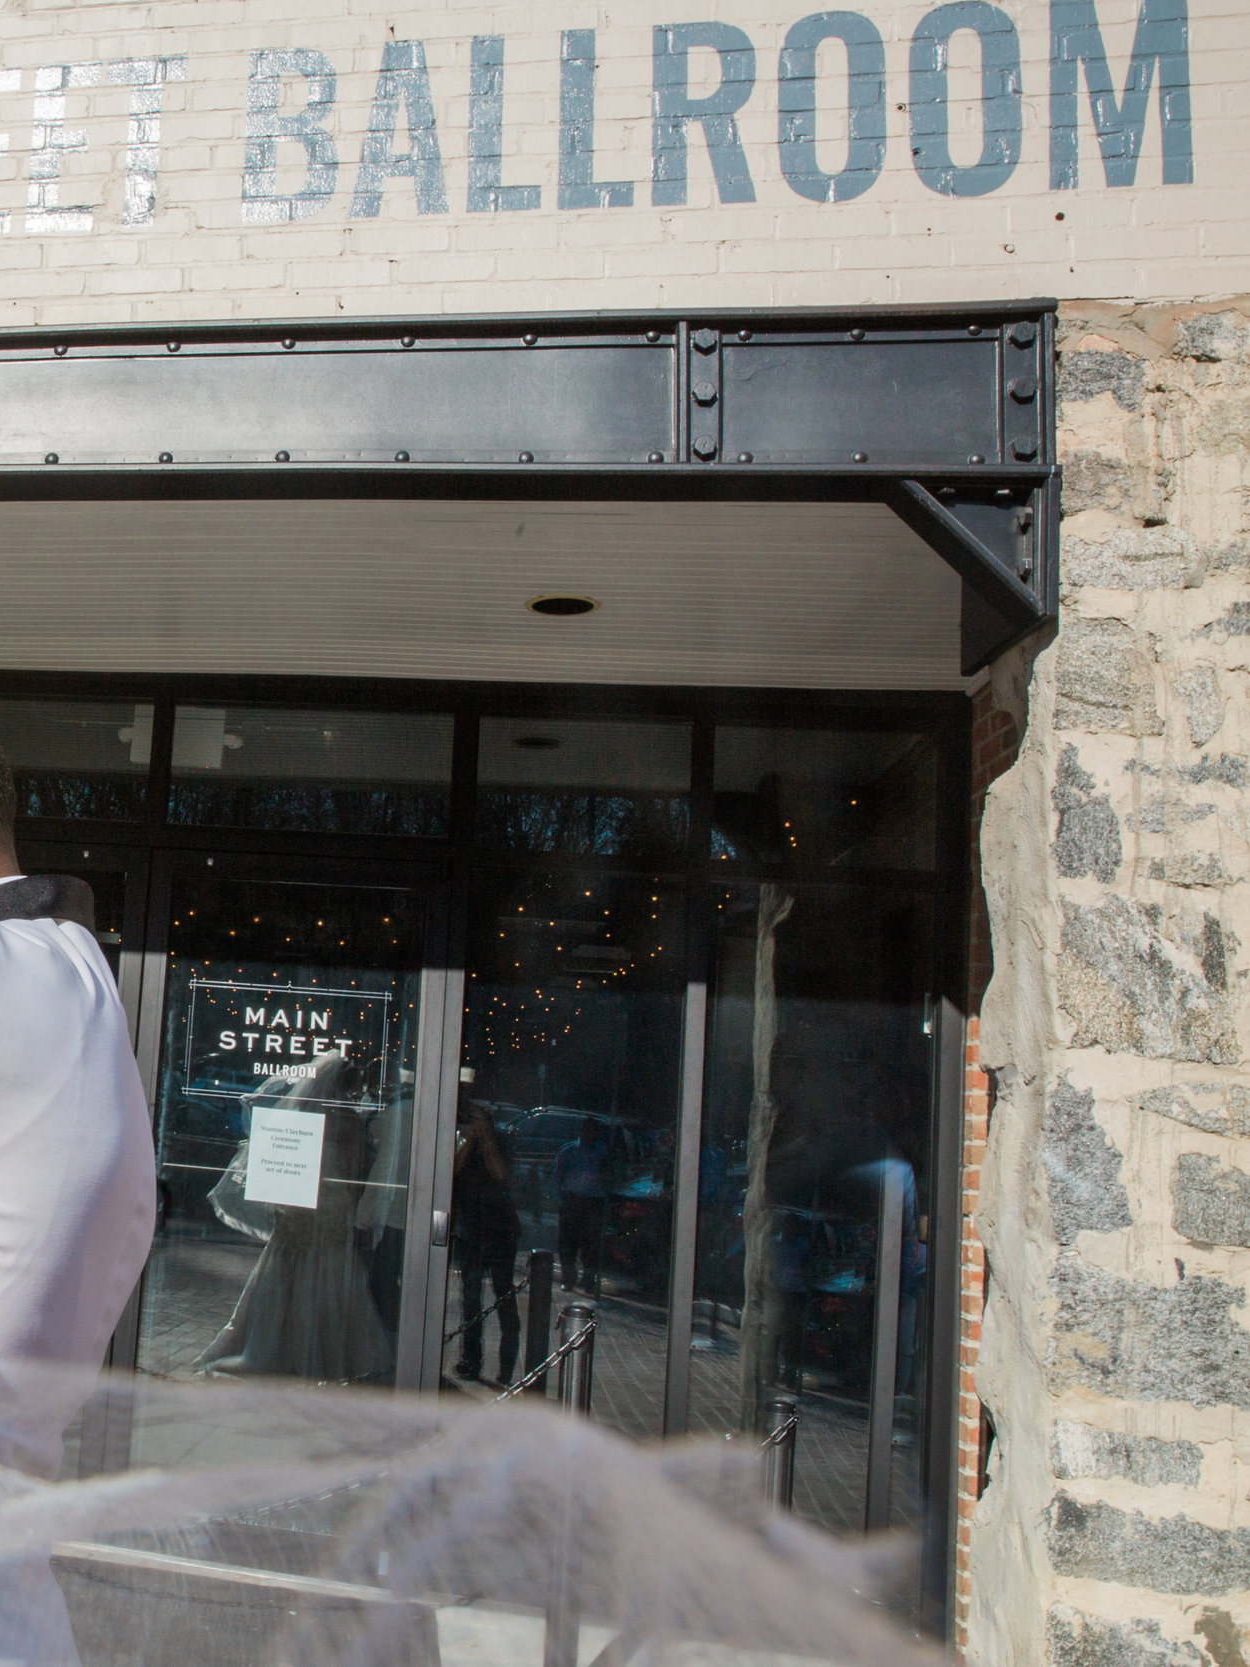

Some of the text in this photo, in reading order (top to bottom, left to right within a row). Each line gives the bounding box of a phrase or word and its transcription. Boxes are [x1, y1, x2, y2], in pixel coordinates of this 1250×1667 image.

[240, 0, 1195, 223] BALLROOM
[245, 1006, 329, 1031] MAIN
[218, 1030, 353, 1059] STREET
[253, 1062, 317, 1080] BALLROOM
[270, 1135, 301, 1144] Ceremony
[272, 1143, 299, 1151] Entrance
[261, 1158, 285, 1167] Proceed
